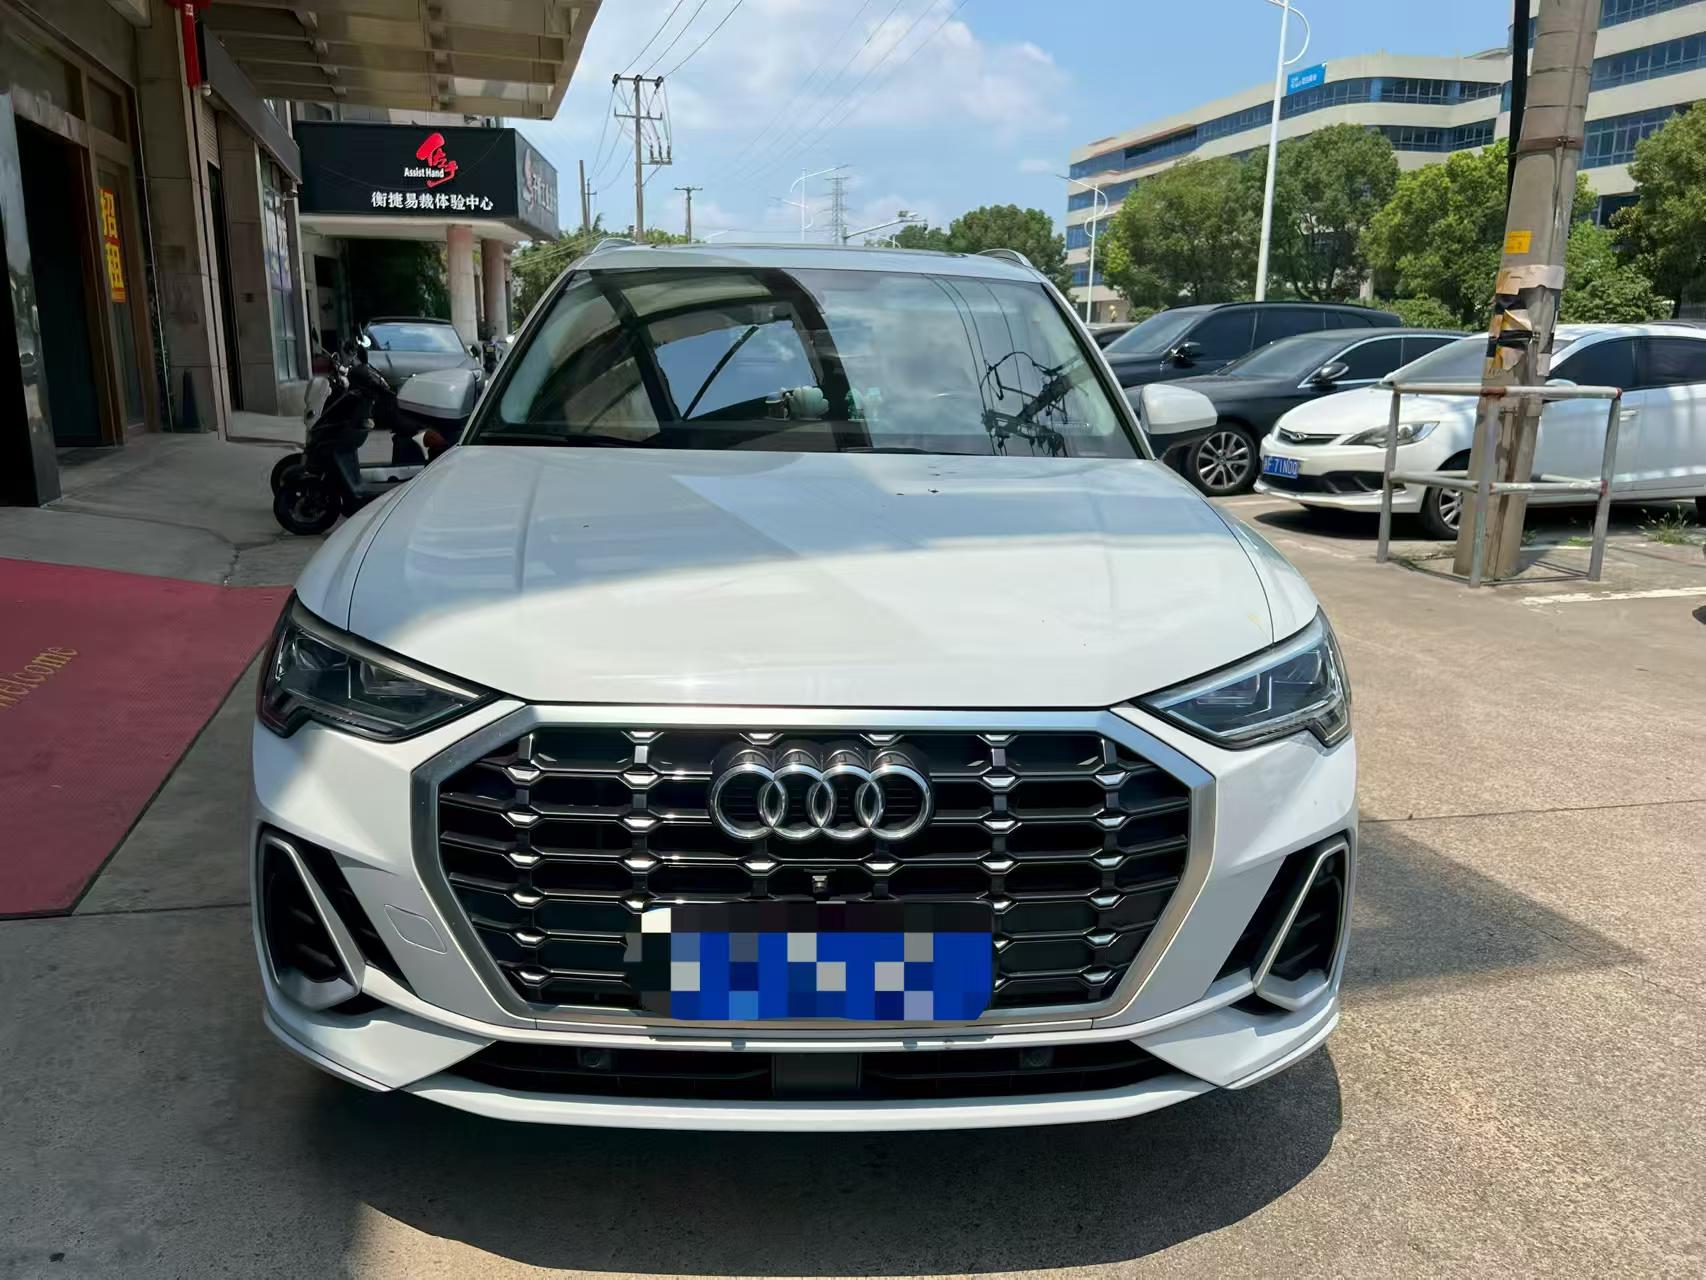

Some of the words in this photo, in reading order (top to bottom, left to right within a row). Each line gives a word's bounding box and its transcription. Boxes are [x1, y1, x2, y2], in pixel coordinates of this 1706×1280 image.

[404, 167, 425, 178] Assist
[426, 167, 445, 178] Hand
[371, 191, 494, 211] 衡捷易裁体验中心
